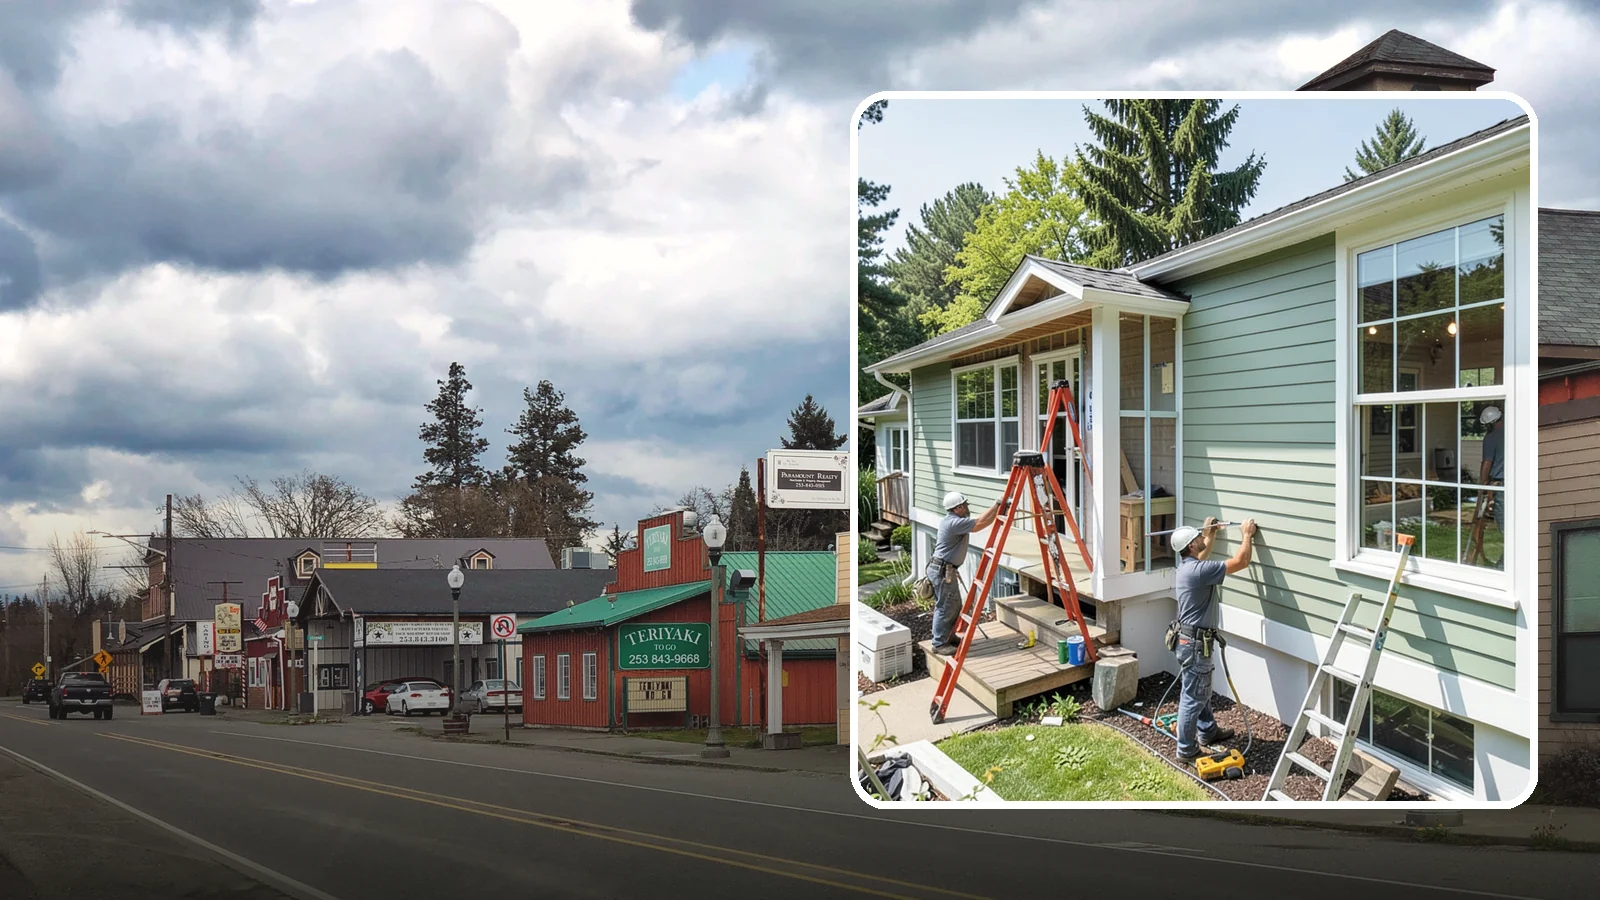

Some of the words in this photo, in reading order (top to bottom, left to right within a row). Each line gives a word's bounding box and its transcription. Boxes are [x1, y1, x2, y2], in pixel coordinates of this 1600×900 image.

[781, 471, 815, 479] PARAMOUNT
[817, 472, 839, 480] REALTY
[625, 627, 702, 646] TERIYAKI
[629, 654, 649, 665] 253
[651, 653, 700, 664] 843-9668
[639, 681, 673, 691] TERIYAKI
